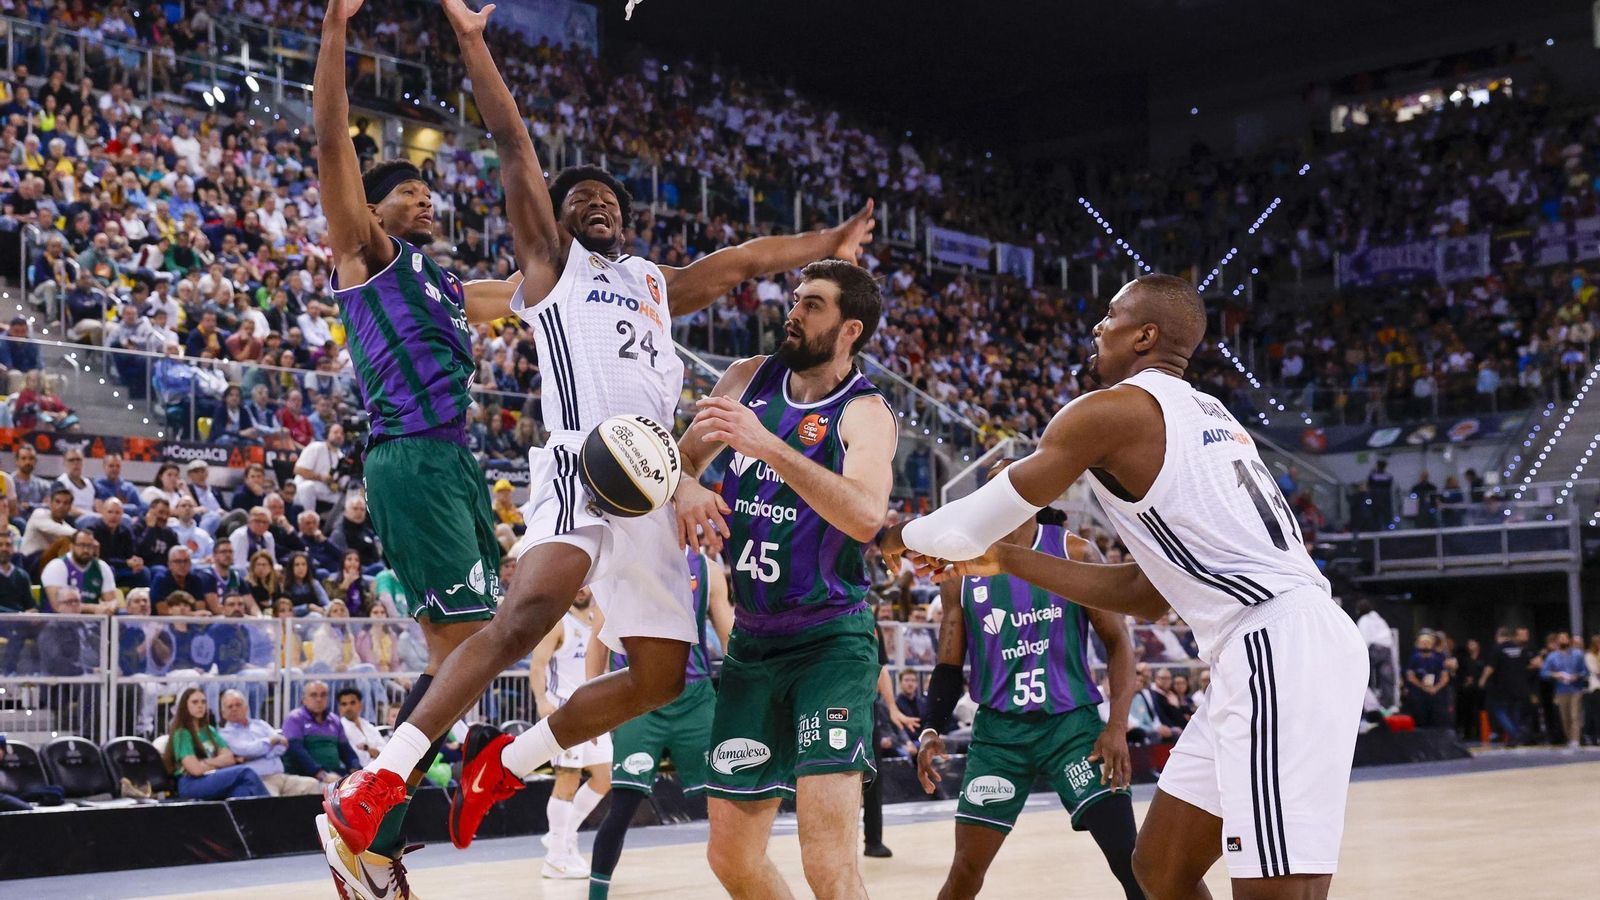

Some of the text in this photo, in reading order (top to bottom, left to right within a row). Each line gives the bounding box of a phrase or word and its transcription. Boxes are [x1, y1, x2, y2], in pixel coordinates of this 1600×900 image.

[616, 320, 659, 368] 24
[611, 425, 654, 478] Copa del Rey
[736, 539, 781, 583] 45
[1010, 604, 1062, 627] Unicaja
[1013, 668, 1047, 706] 55
[828, 712, 844, 720] acb
